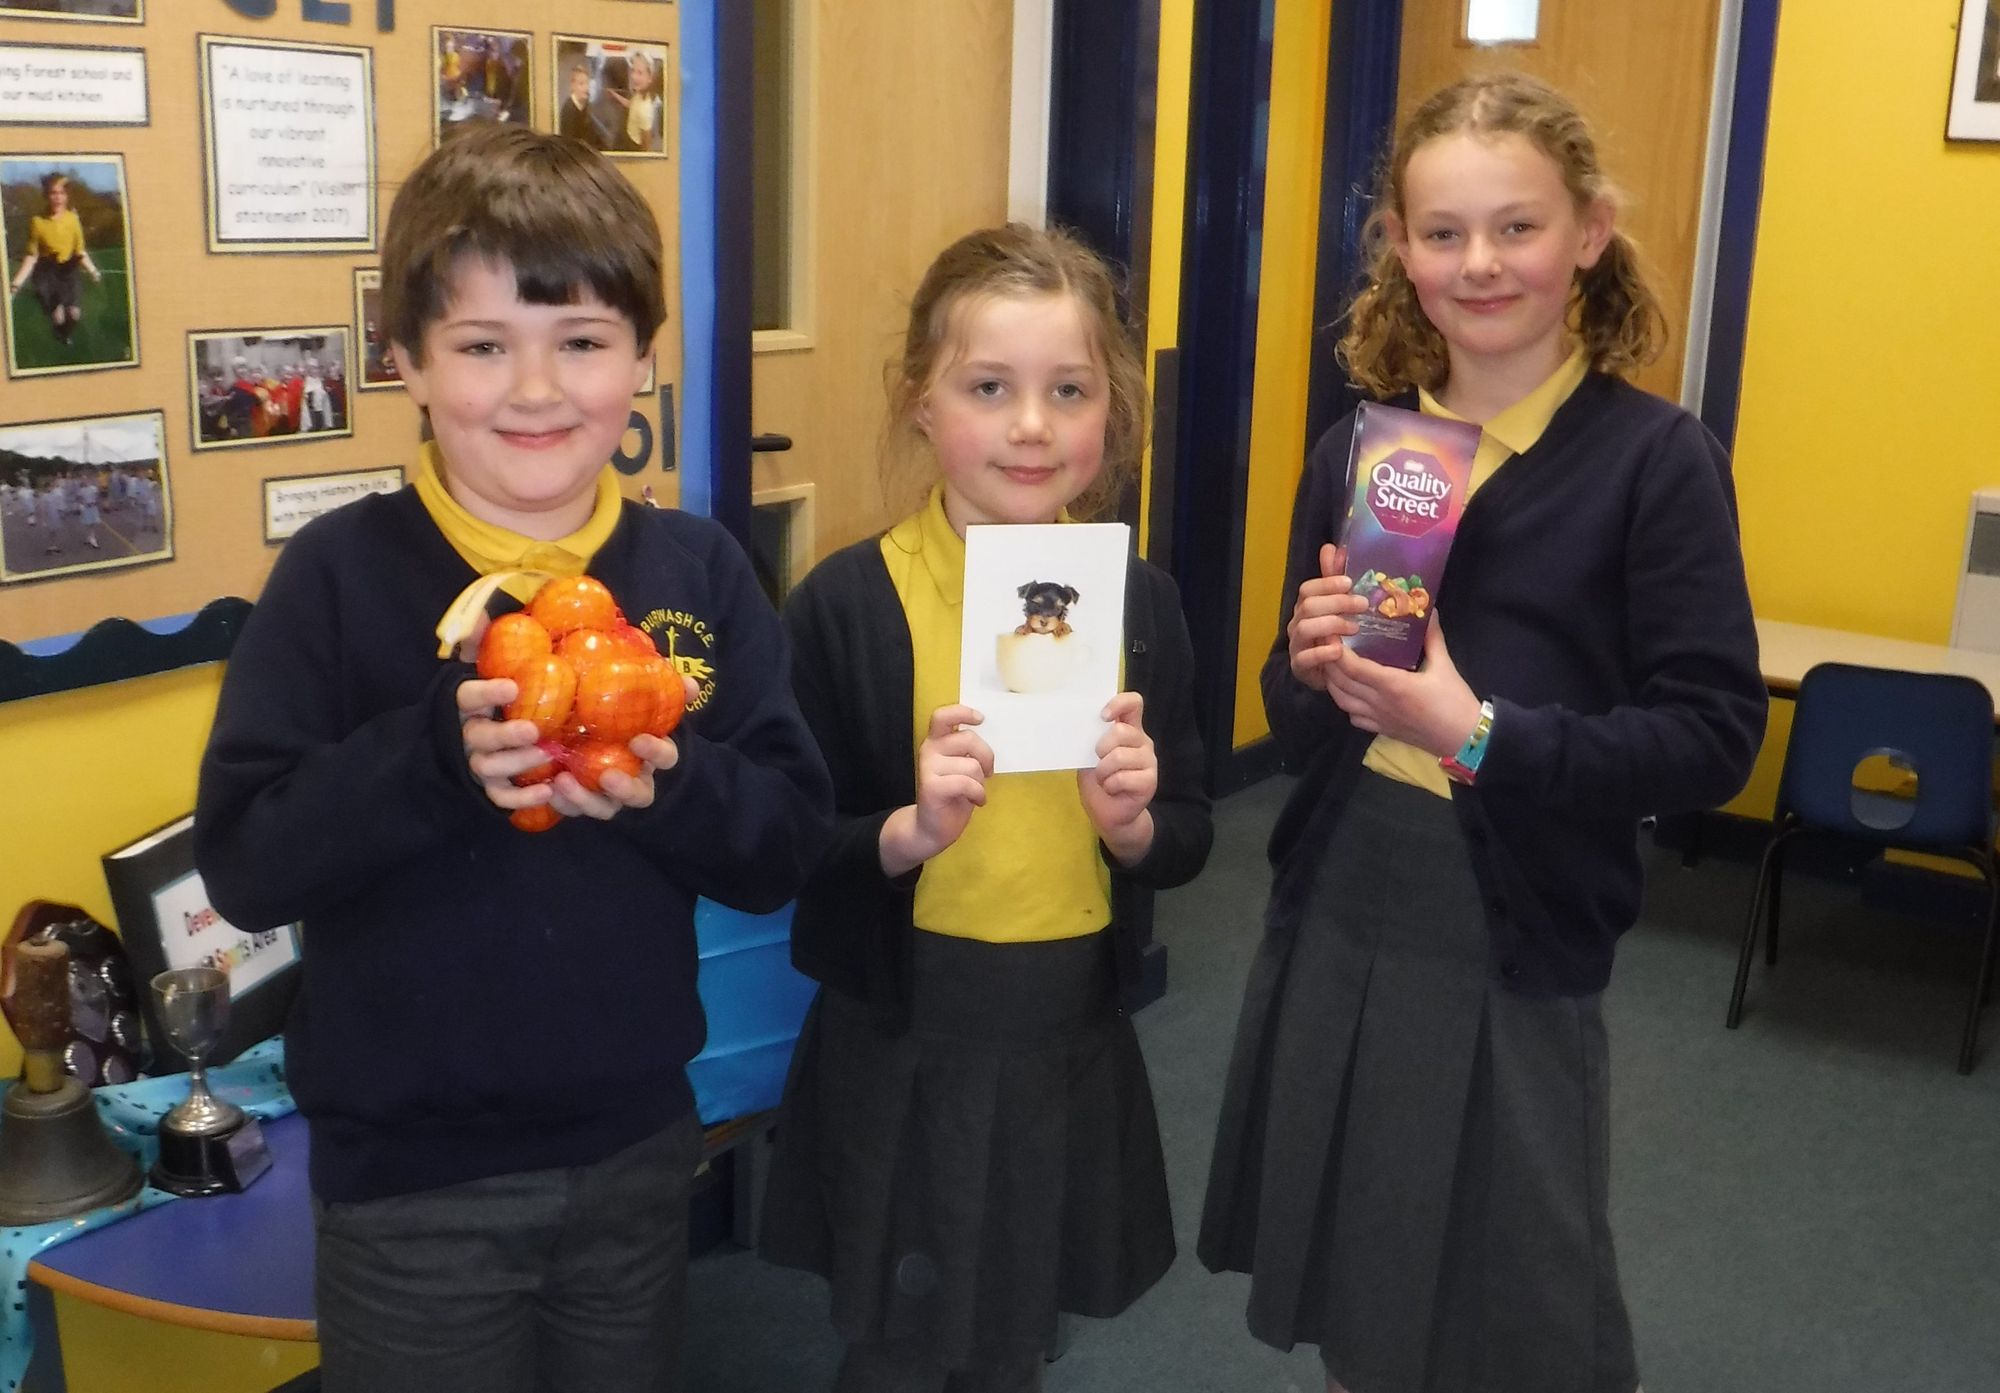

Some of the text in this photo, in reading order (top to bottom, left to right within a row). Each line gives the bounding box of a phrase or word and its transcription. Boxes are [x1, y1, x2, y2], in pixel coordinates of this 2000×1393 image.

[25, 63, 66, 78] Forest
[71, 67, 107, 80] school
[112, 69, 132, 81] and
[245, 68, 273, 84] love
[277, 68, 292, 84] of
[299, 71, 352, 92] learning
[58, 89, 103, 103] kitchen
[220, 97, 356, 119] is nurtured through
[249, 124, 326, 142] our vibrant
[258, 154, 326, 169] innovative
[236, 207, 350, 226] statement 2017)
[1372, 462, 1452, 501] Quality
[1375, 486, 1440, 519] Street
[640, 608, 693, 634] BURWASH
[683, 661, 691, 673] B
